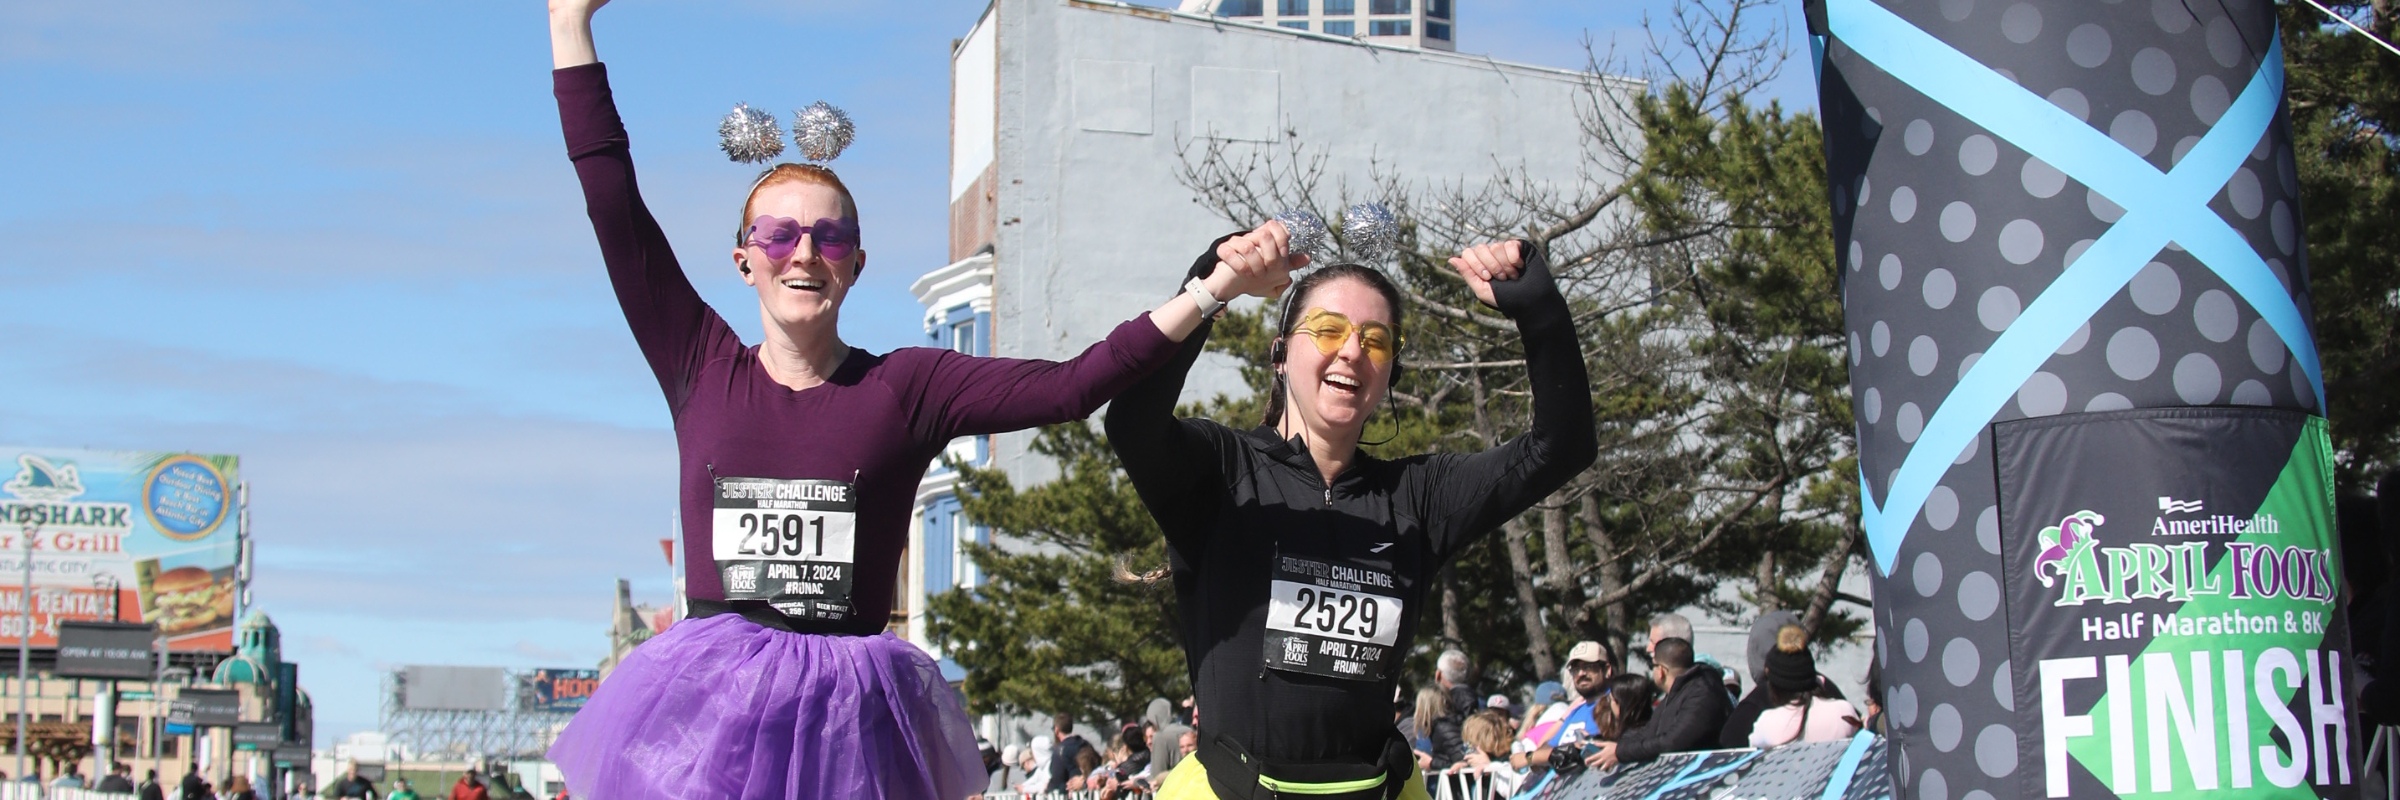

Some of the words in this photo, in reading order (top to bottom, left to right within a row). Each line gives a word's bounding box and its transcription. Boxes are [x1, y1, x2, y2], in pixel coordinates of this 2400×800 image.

[159, 473, 191, 490] Outdoor
[194, 484, 221, 501] Dining
[197, 474, 214, 485] Best
[722, 482, 773, 499] JESTER
[776, 484, 847, 502] CHALLENGE
[757, 500, 773, 508] HALF
[774, 501, 808, 510] MARATHON
[155, 506, 187, 521] Atlantic
[189, 516, 207, 528] City
[2151, 513, 2280, 536] AmeriHealth
[53, 532, 120, 552] Grill
[737, 513, 824, 556] 2591
[0, 560, 55, 573] TLANTIC
[59, 562, 88, 574] CITY
[732, 566, 756, 579] APRIL
[768, 564, 799, 579] APRIL
[801, 566, 810, 581] 7,
[813, 566, 841, 581] 2024
[1282, 557, 1330, 578] JESTER
[1331, 566, 1394, 589] CHALLENGE
[2055, 538, 2221, 606] APRIL
[2225, 542, 2335, 605] FOOLS
[731, 579, 756, 590] FOOLS
[785, 582, 824, 595] #RUNAC
[1316, 577, 1330, 586] HALF
[1330, 580, 1361, 591] MARATHON
[789, 608, 806, 616] 2591
[1294, 588, 1378, 638] 2529
[2082, 612, 2144, 641] Half
[2153, 609, 2278, 637] Marathon
[2284, 611, 2298, 634] &
[2302, 612, 2325, 635] 8K
[61, 647, 86, 658] OPEN
[89, 648, 102, 657] AT
[1285, 639, 1309, 653] APRIL
[1320, 641, 1348, 657] APRIL
[1350, 645, 1359, 660] 7,
[1361, 647, 1382, 661] 2024
[1284, 651, 1308, 662] FOOLS
[1333, 659, 1366, 675] #RUNAC
[2039, 647, 2351, 799] FINISH
